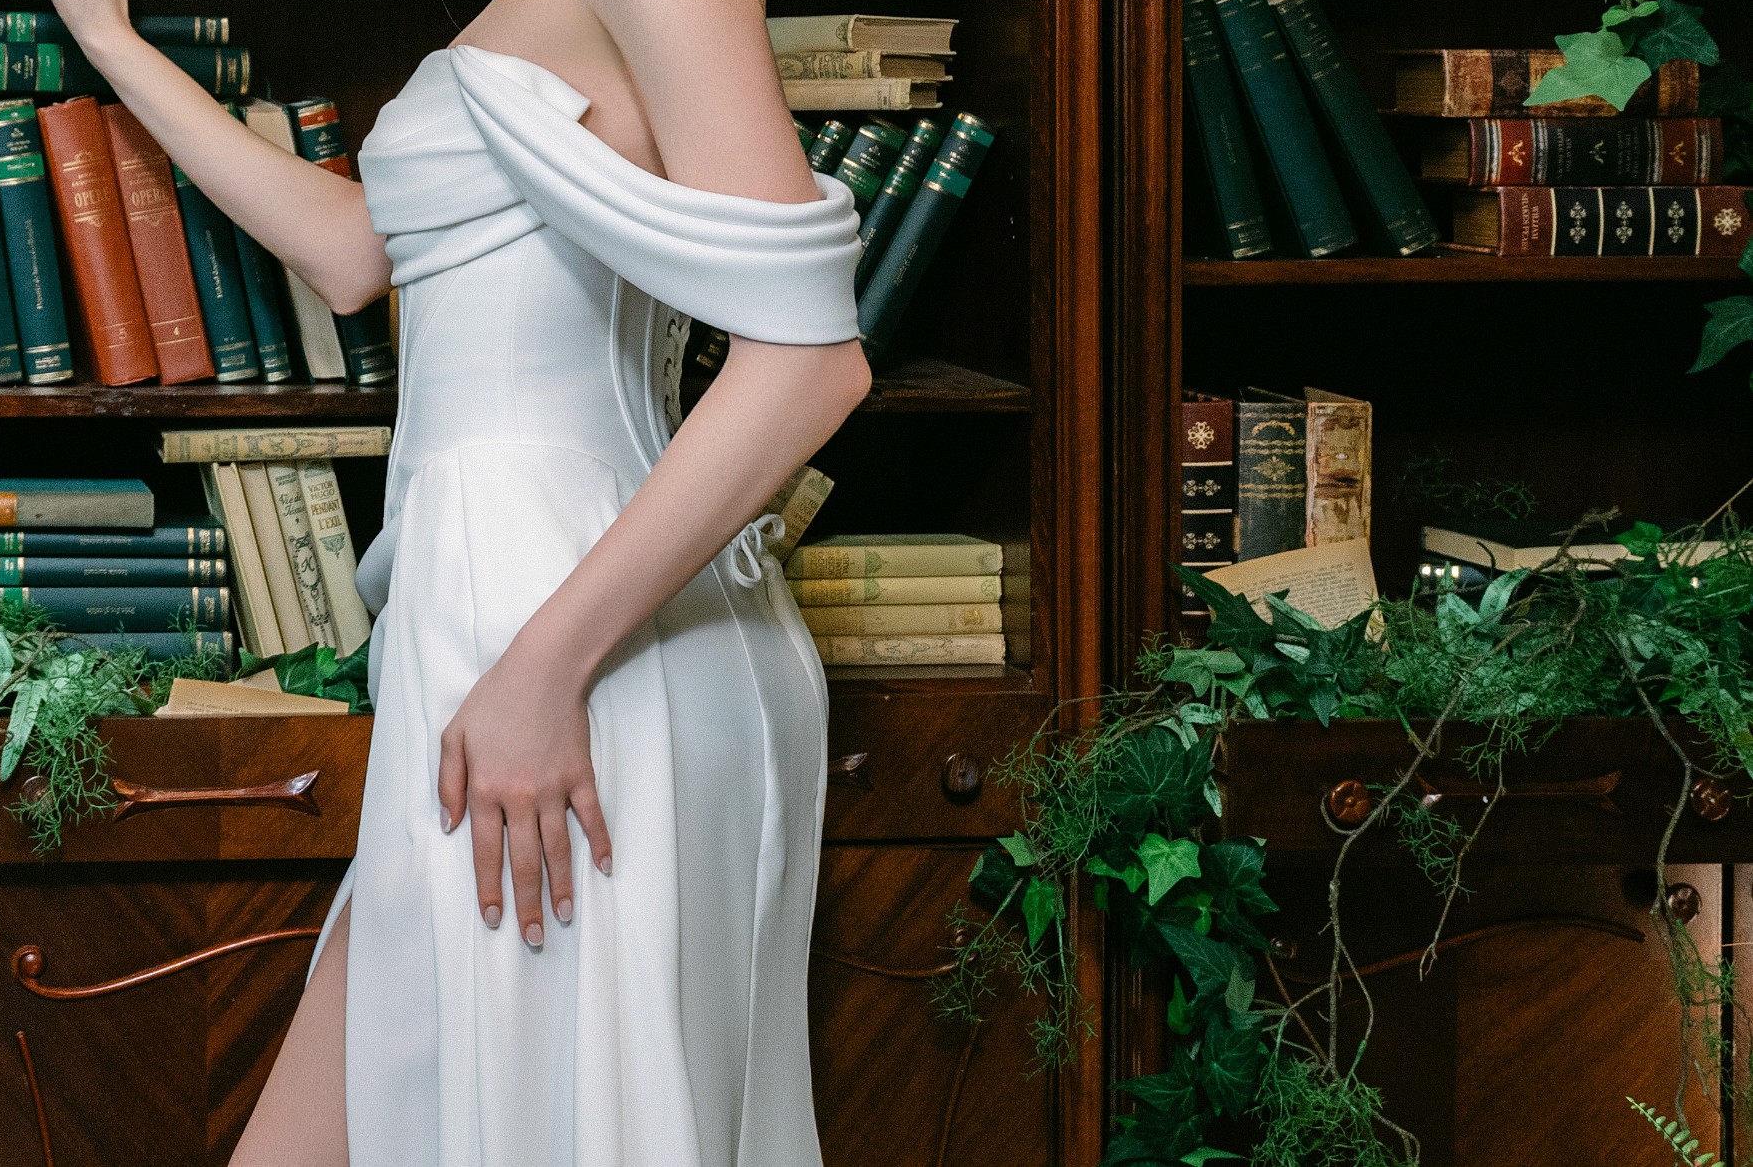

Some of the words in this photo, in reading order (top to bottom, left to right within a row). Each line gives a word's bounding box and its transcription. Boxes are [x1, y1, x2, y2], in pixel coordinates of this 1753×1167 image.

[308, 480, 334, 493] VICTOR
[310, 498, 341, 516] PENDANT
[318, 515, 343, 531] L'EXIL
